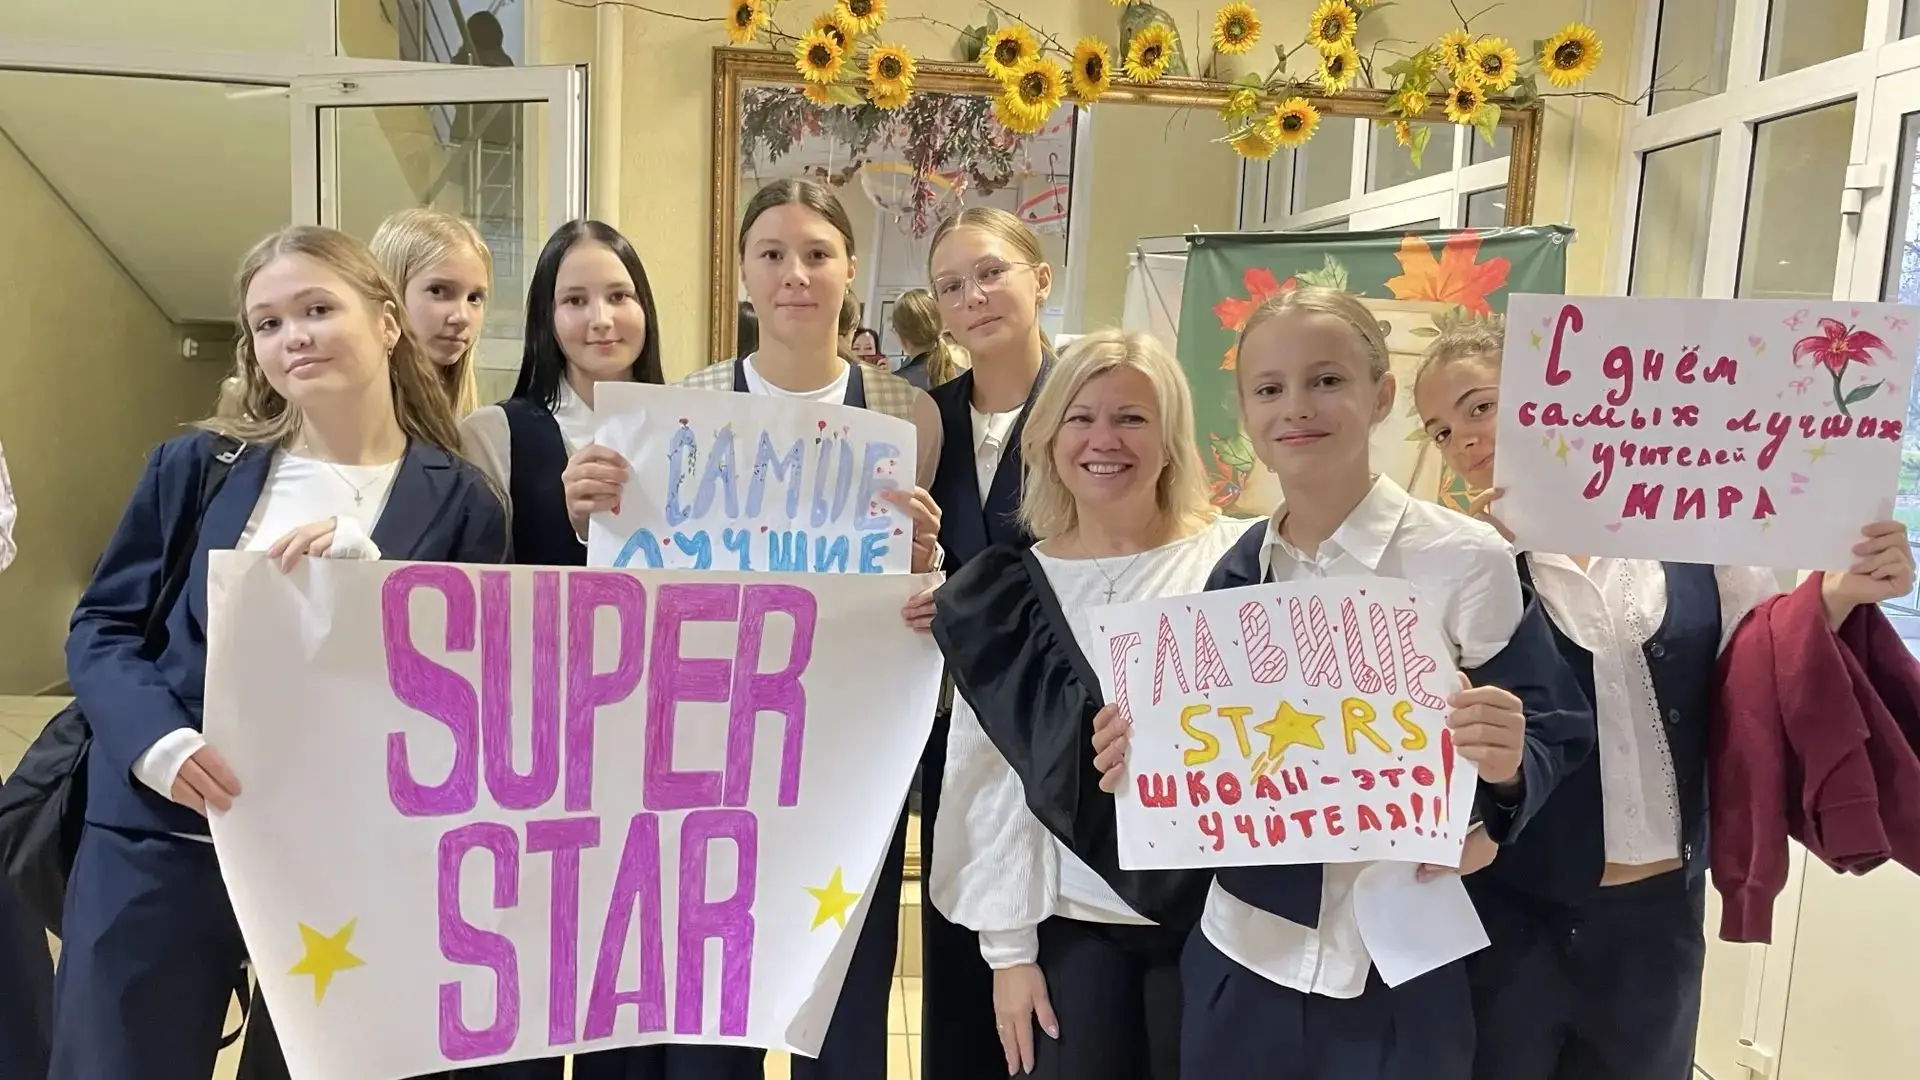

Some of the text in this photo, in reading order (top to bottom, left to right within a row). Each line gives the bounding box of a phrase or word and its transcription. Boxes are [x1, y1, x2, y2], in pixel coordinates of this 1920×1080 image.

[1545, 304, 1738, 406] С днём
[665, 425, 901, 531] САМЫЕ
[1518, 401, 1903, 471] самых лучших
[1582, 439, 1747, 500] учителей
[1621, 482, 1777, 521] МИРА
[381, 564, 819, 818] SUPER
[1110, 595, 1446, 724] ГЛАВНЫЕ
[1136, 766, 1309, 808] ШКОЛЫ
[438, 810, 759, 1062] STAR
